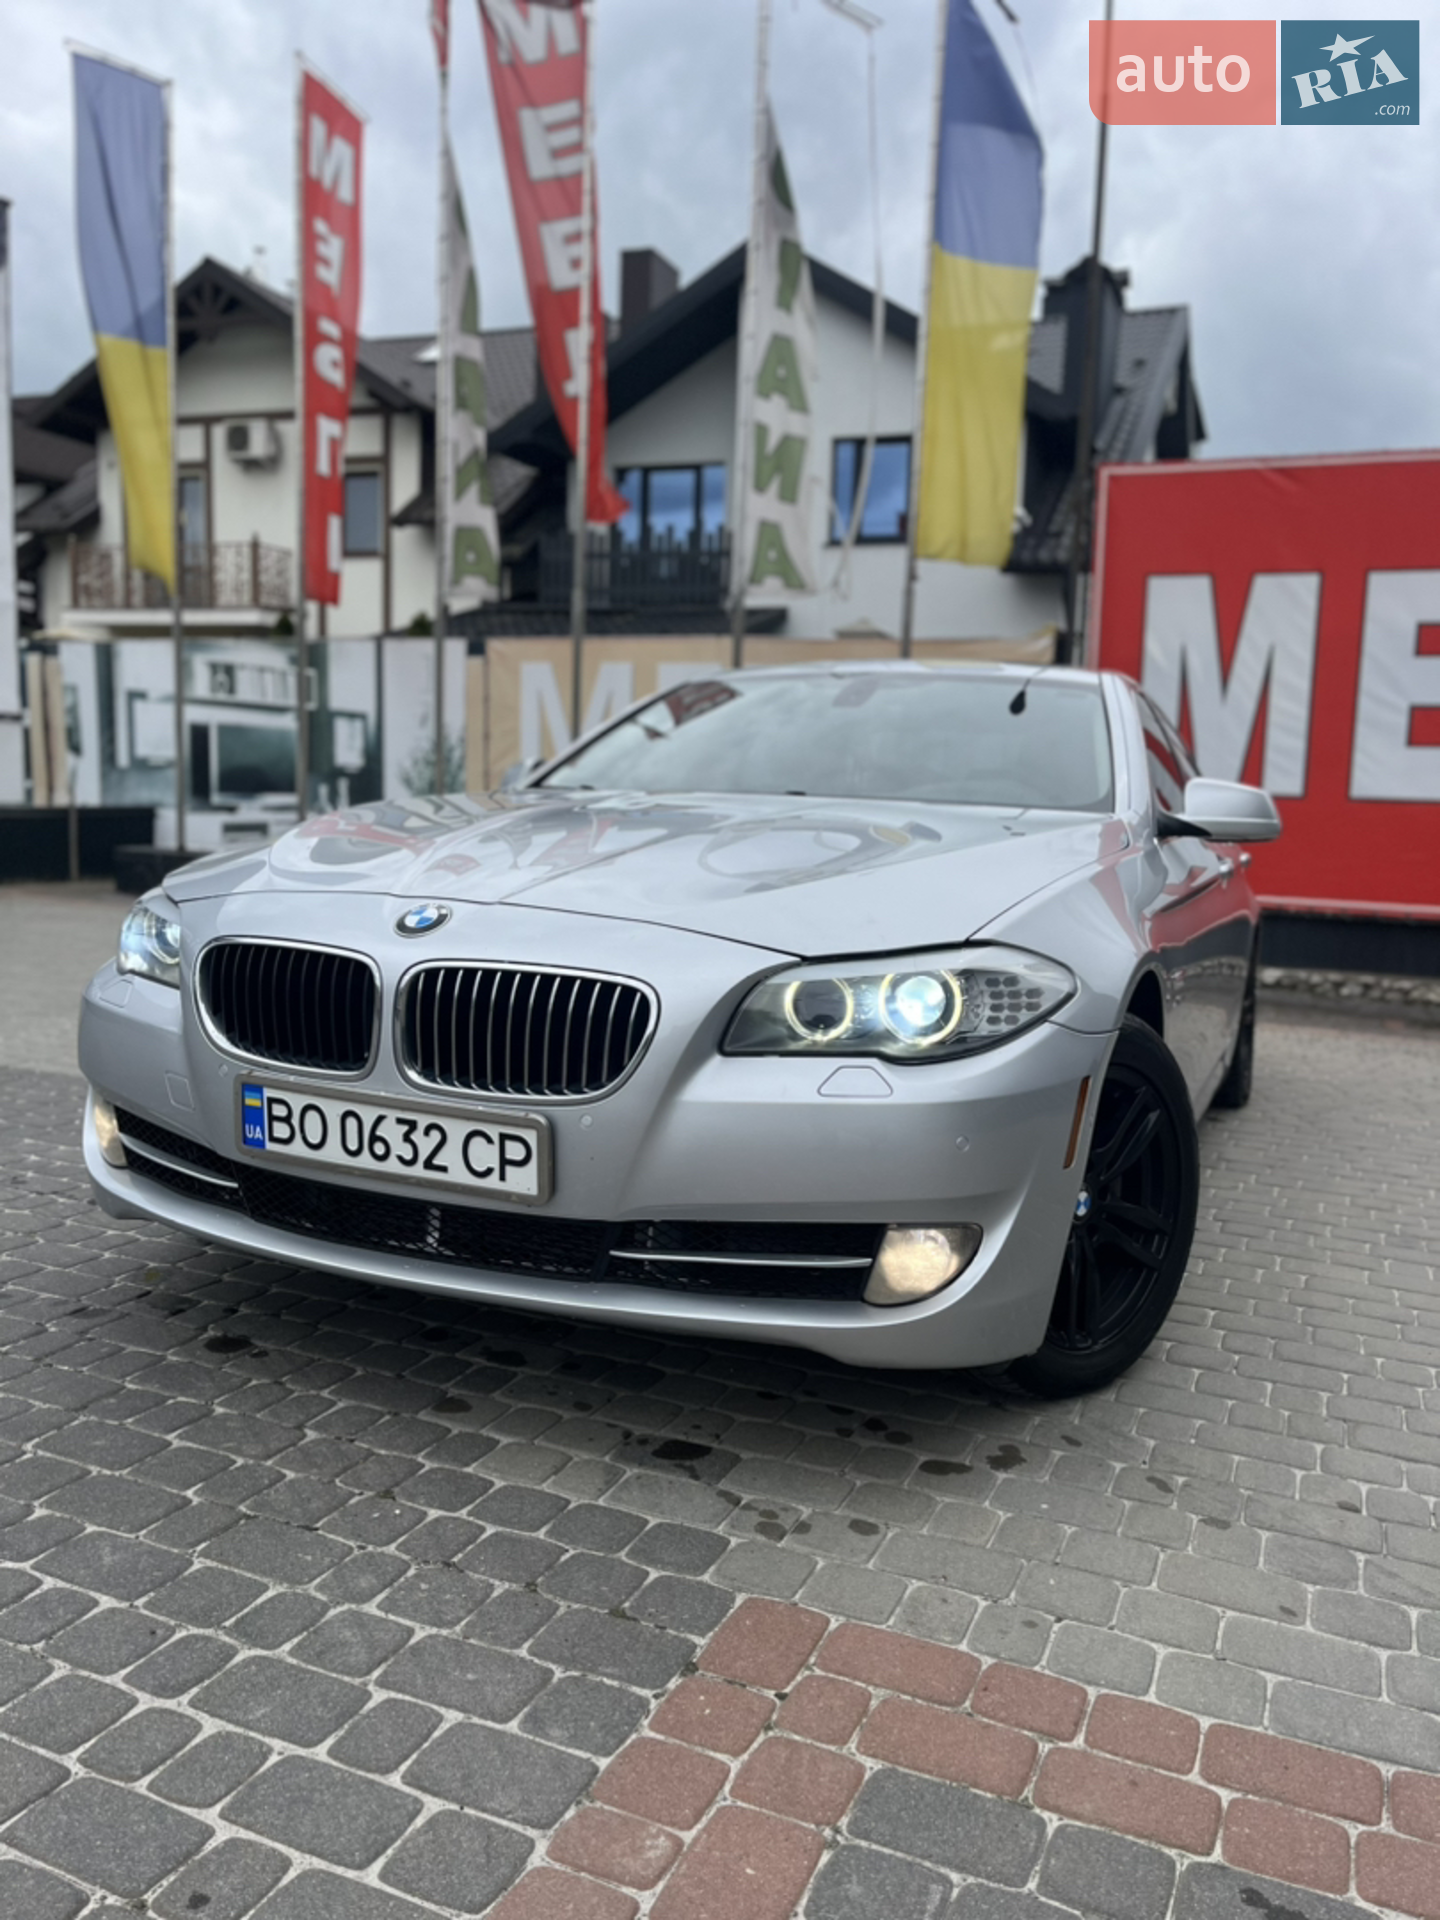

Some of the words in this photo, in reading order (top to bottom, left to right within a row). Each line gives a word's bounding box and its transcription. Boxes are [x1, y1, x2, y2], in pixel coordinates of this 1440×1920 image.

[245, 1124, 263, 1140] UA
[266, 1096, 328, 1151] BO
[340, 1110, 449, 1173] 0632
[462, 1129, 532, 1182] CP
